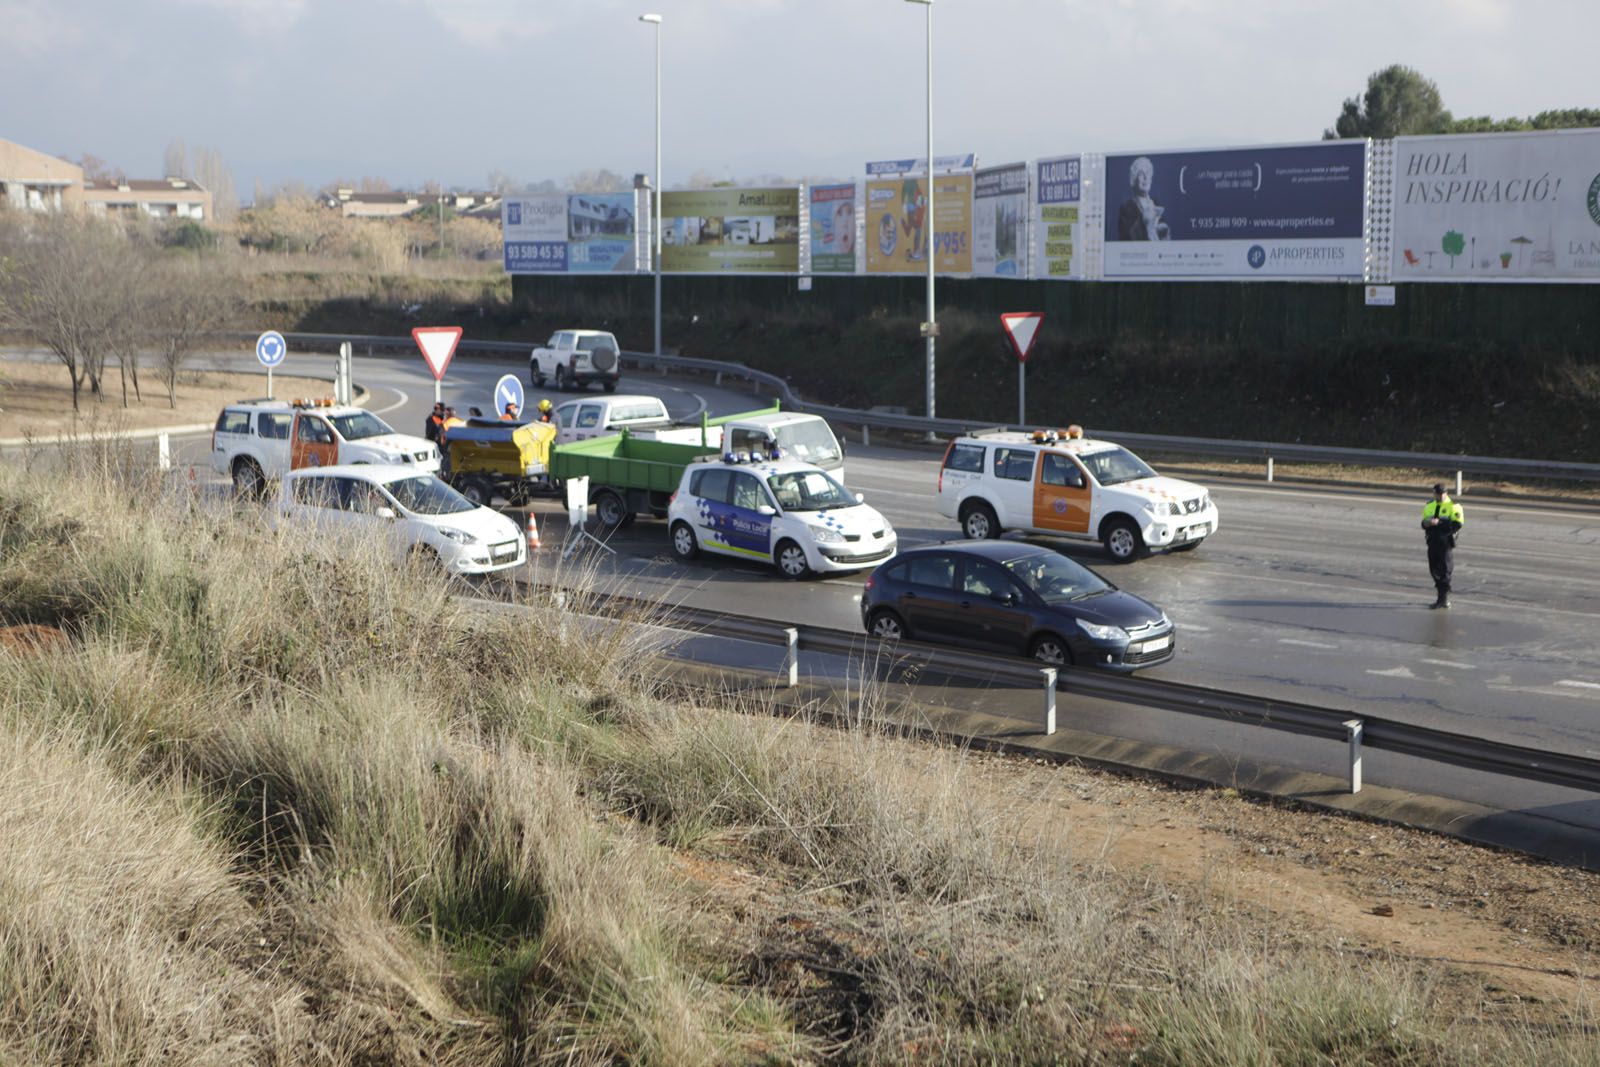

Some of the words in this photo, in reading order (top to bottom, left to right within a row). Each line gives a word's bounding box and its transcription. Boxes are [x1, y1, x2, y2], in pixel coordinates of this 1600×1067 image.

[1406, 152, 1467, 175] HOLA
[1042, 161, 1078, 183] ALQUILER
[1404, 172, 1561, 204] INSPIRACIÓ!
[523, 201, 563, 216] Prodigia
[1198, 218, 1214, 228] 935
[1232, 217, 1247, 228] 909
[1253, 216, 1335, 229] www.aproperties.es
[508, 246, 519, 259] 93
[539, 246, 551, 259] 45
[552, 246, 564, 259] 36
[1270, 247, 1345, 260] APROPERTIES
[1568, 240, 1584, 254] LA
